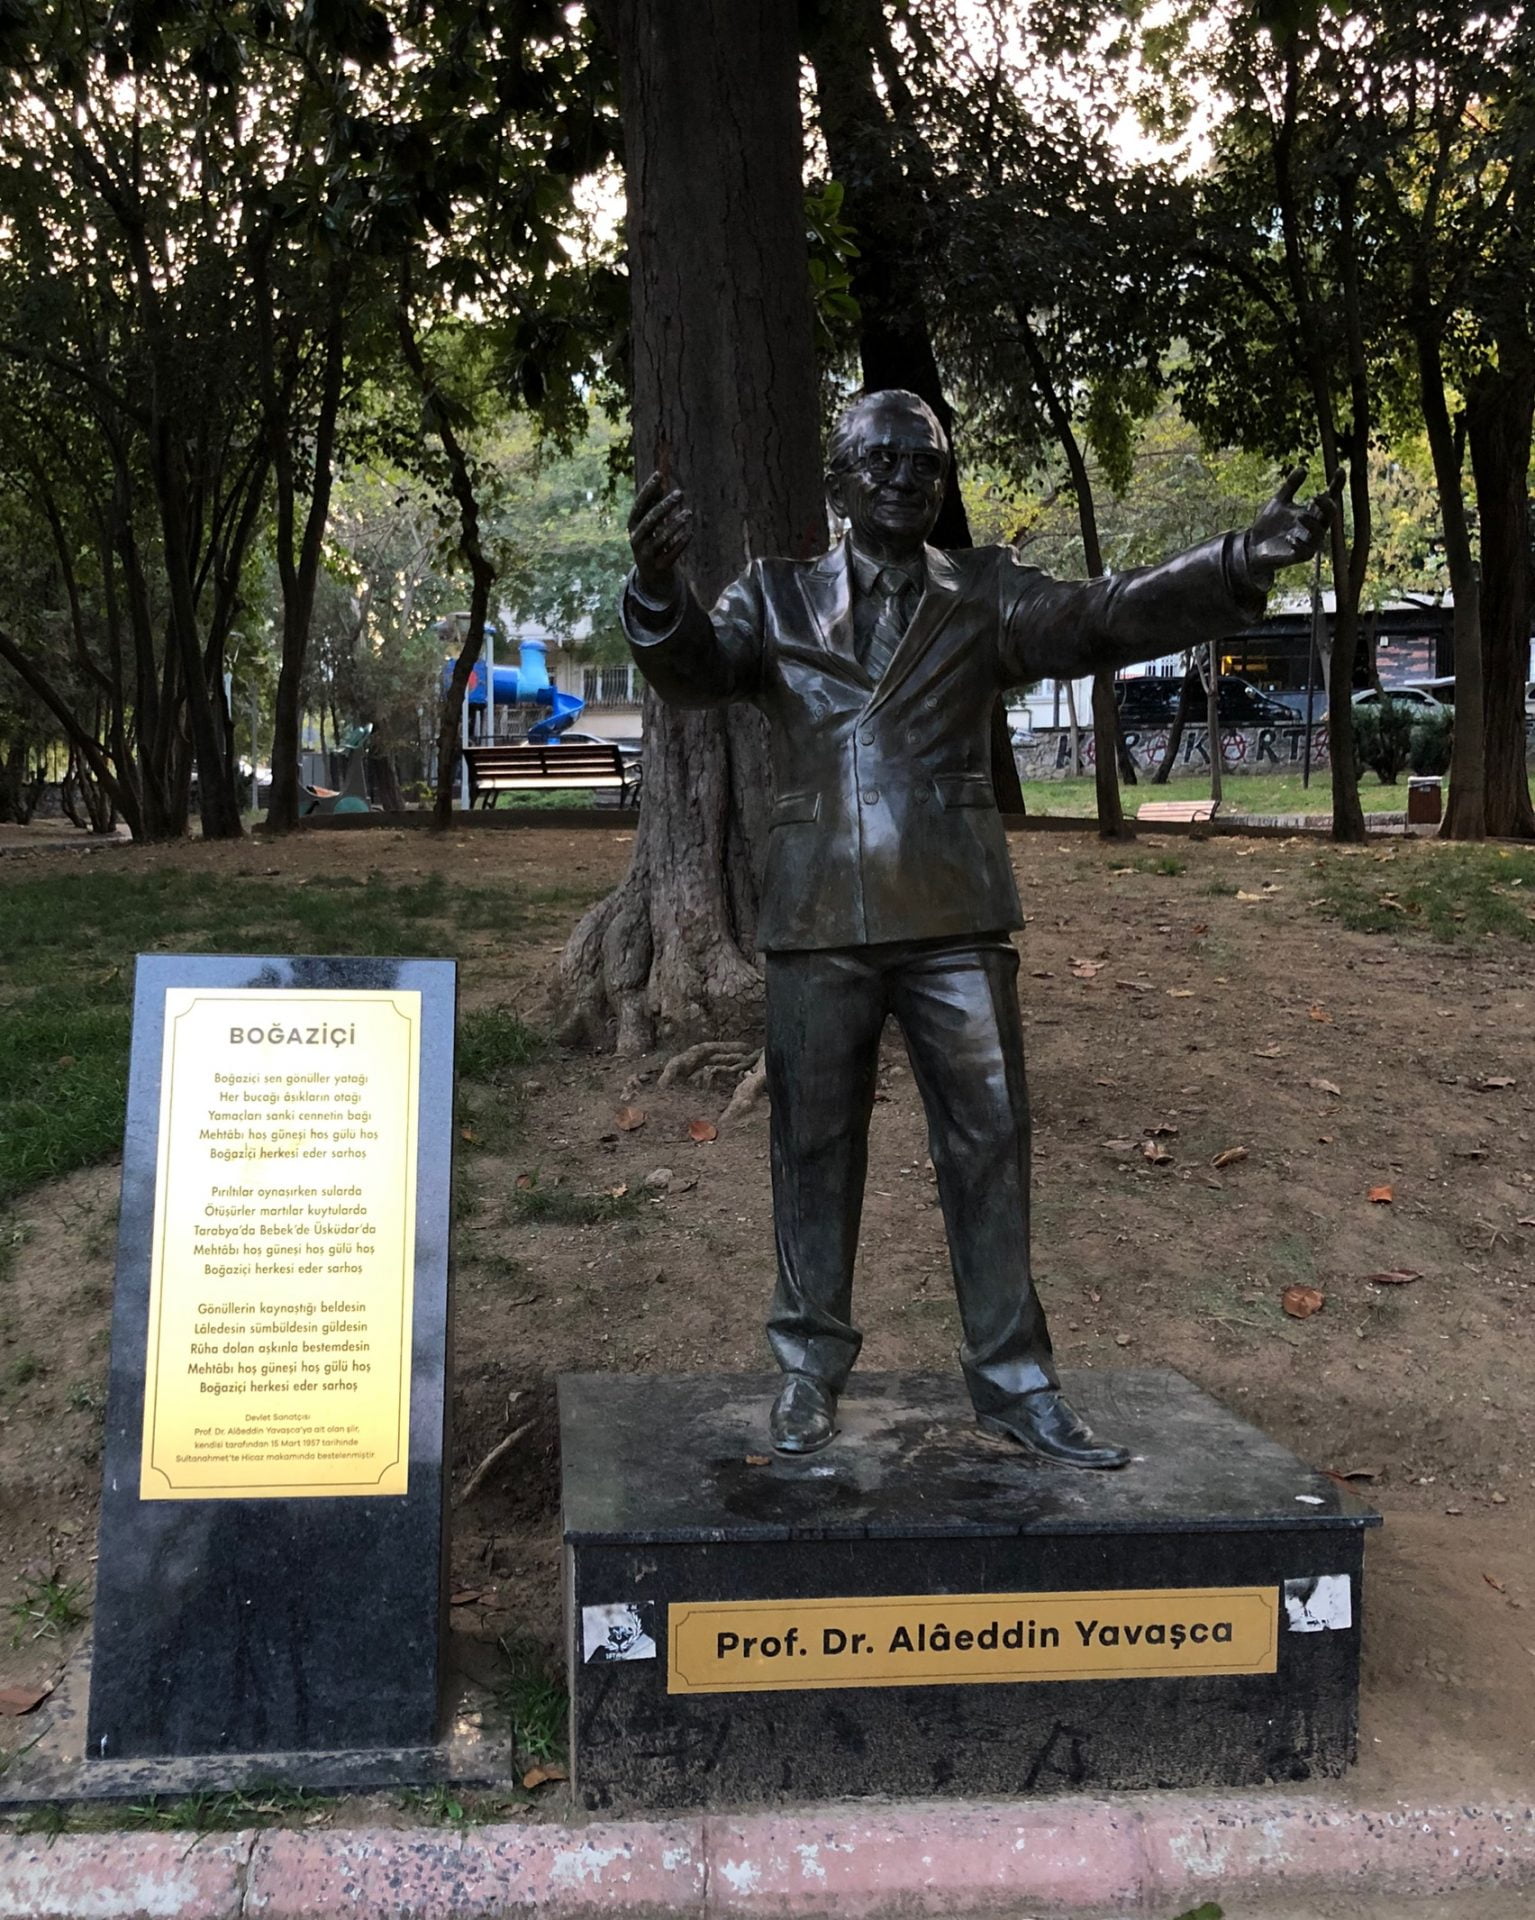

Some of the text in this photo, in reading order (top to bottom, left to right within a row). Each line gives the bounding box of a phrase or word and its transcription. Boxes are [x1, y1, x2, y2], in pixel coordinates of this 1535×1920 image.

[230, 1022, 355, 1048] BOĞAZİÇİ
[214, 1072, 368, 1086] Boğaziçi sen gönüller yatağı
[220, 1092, 239, 1102] Her
[243, 1091, 280, 1105] bucağı
[334, 1092, 361, 1104] otağı
[208, 1110, 371, 1123] Yamaçları sanki cennetin bağı
[271, 1129, 306, 1142] güneşi
[333, 1129, 356, 1142] gülü
[260, 1147, 298, 1158] herkesi
[303, 1147, 327, 1158] eder
[332, 1147, 366, 1160] sarhoş
[212, 1186, 254, 1197] Pırıltılar
[322, 1185, 362, 1196] sularda
[205, 1203, 367, 1218] Ötüşürler martılar kuytularda
[266, 1244, 301, 1257] güneşi
[329, 1242, 352, 1256] gülü
[205, 1262, 362, 1278] Boğaziçi herkesi eder sarhoş
[198, 1301, 365, 1316] Gönüllerin kaynaştığı beldesin
[250, 1321, 317, 1333] sümbüldesin
[322, 1320, 367, 1335] güldesin
[223, 1342, 254, 1353] dolan
[258, 1341, 298, 1354] aşkınla
[303, 1340, 369, 1352] bestemdesin
[261, 1362, 296, 1376] güneşi
[324, 1360, 348, 1375] gülü
[200, 1379, 357, 1396] Boğaziçi herkesi eder sarhoş
[327, 1425, 345, 1433] olan
[194, 1441, 223, 1449] kendisi
[303, 1439, 320, 1447] 1957
[716, 1617, 1233, 1659] Prof. Dr. Alâeddin Yavaşca
